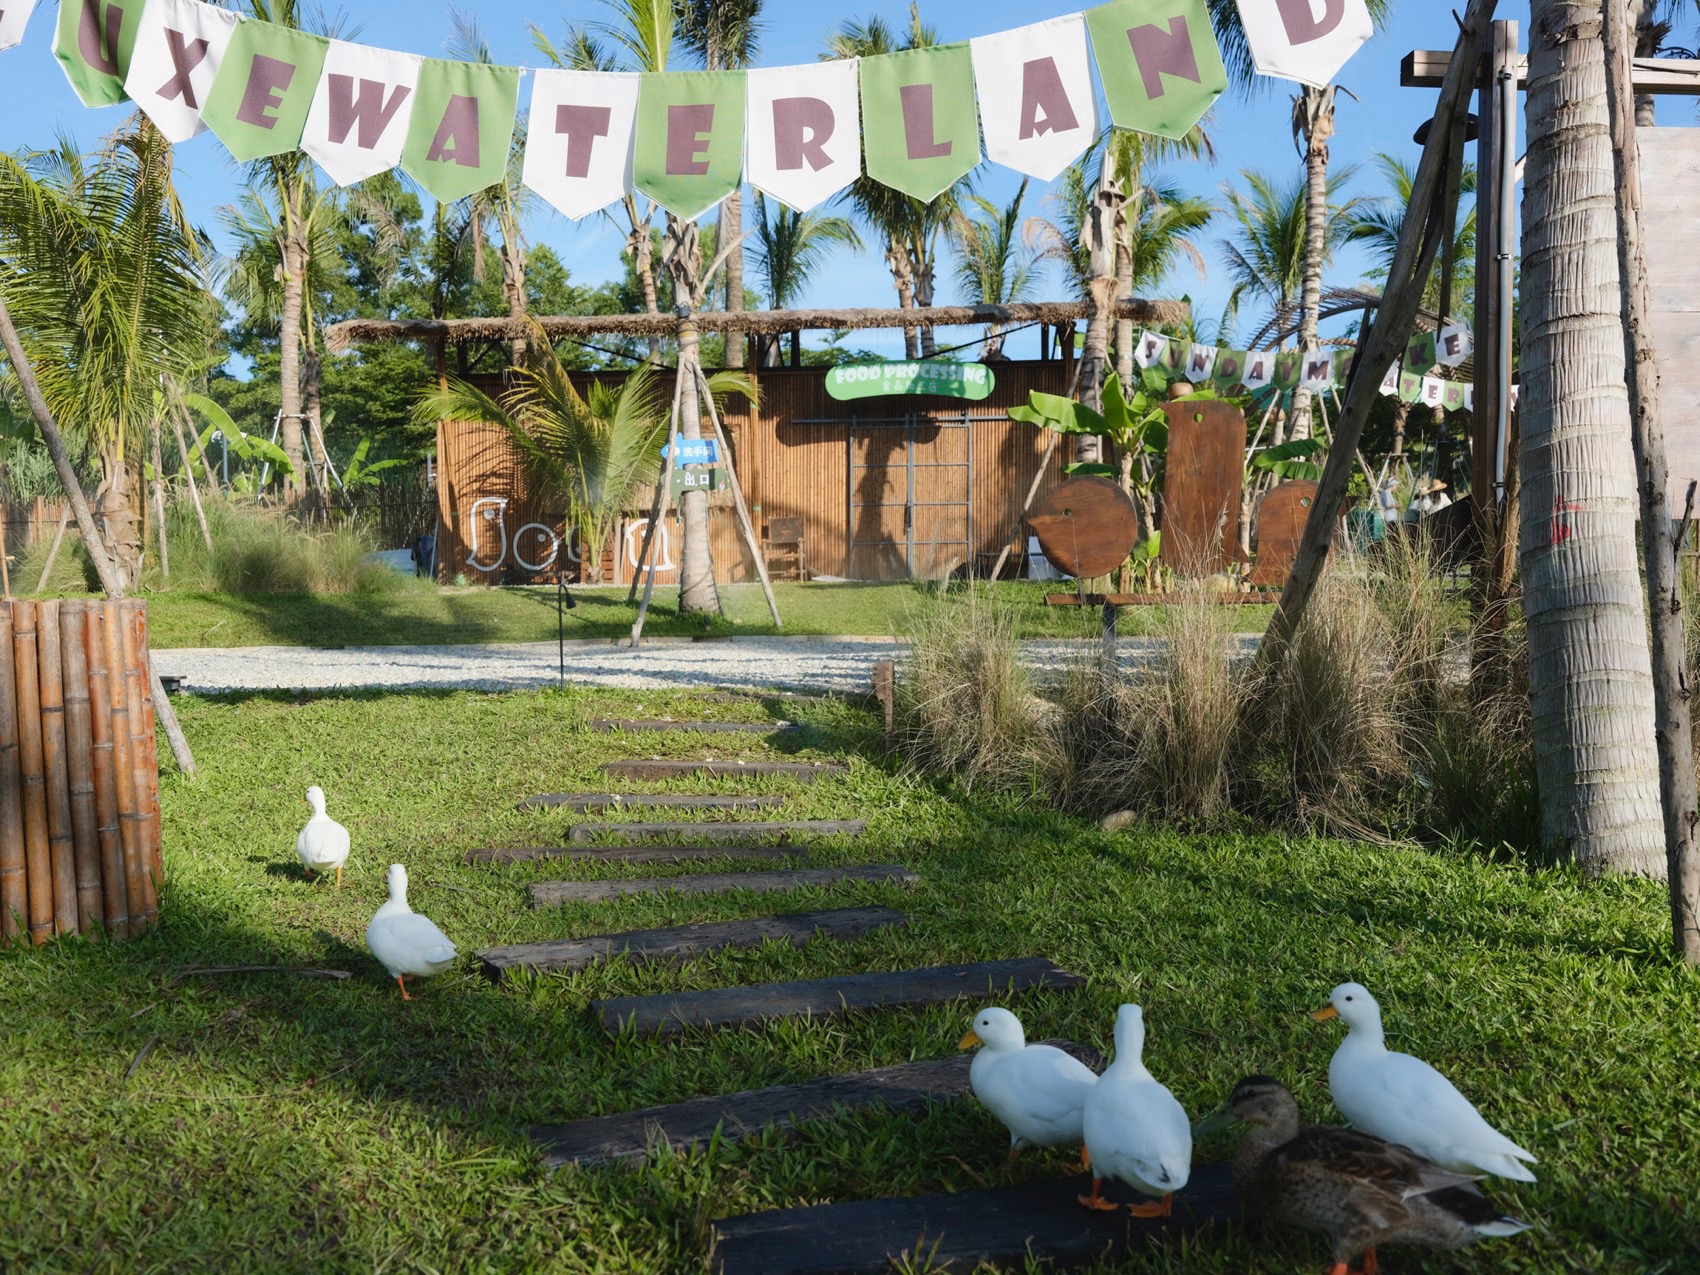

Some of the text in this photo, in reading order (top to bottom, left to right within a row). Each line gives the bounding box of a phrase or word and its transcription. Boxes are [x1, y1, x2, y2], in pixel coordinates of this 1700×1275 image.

[0, 0, 1344, 178] UXEWATERLAND
[835, 363, 987, 385] FOOD PROCESSING
[882, 380, 937, 392] 食品加工店
[683, 446, 713, 457] 洗手间
[685, 472, 709, 486] 出口
